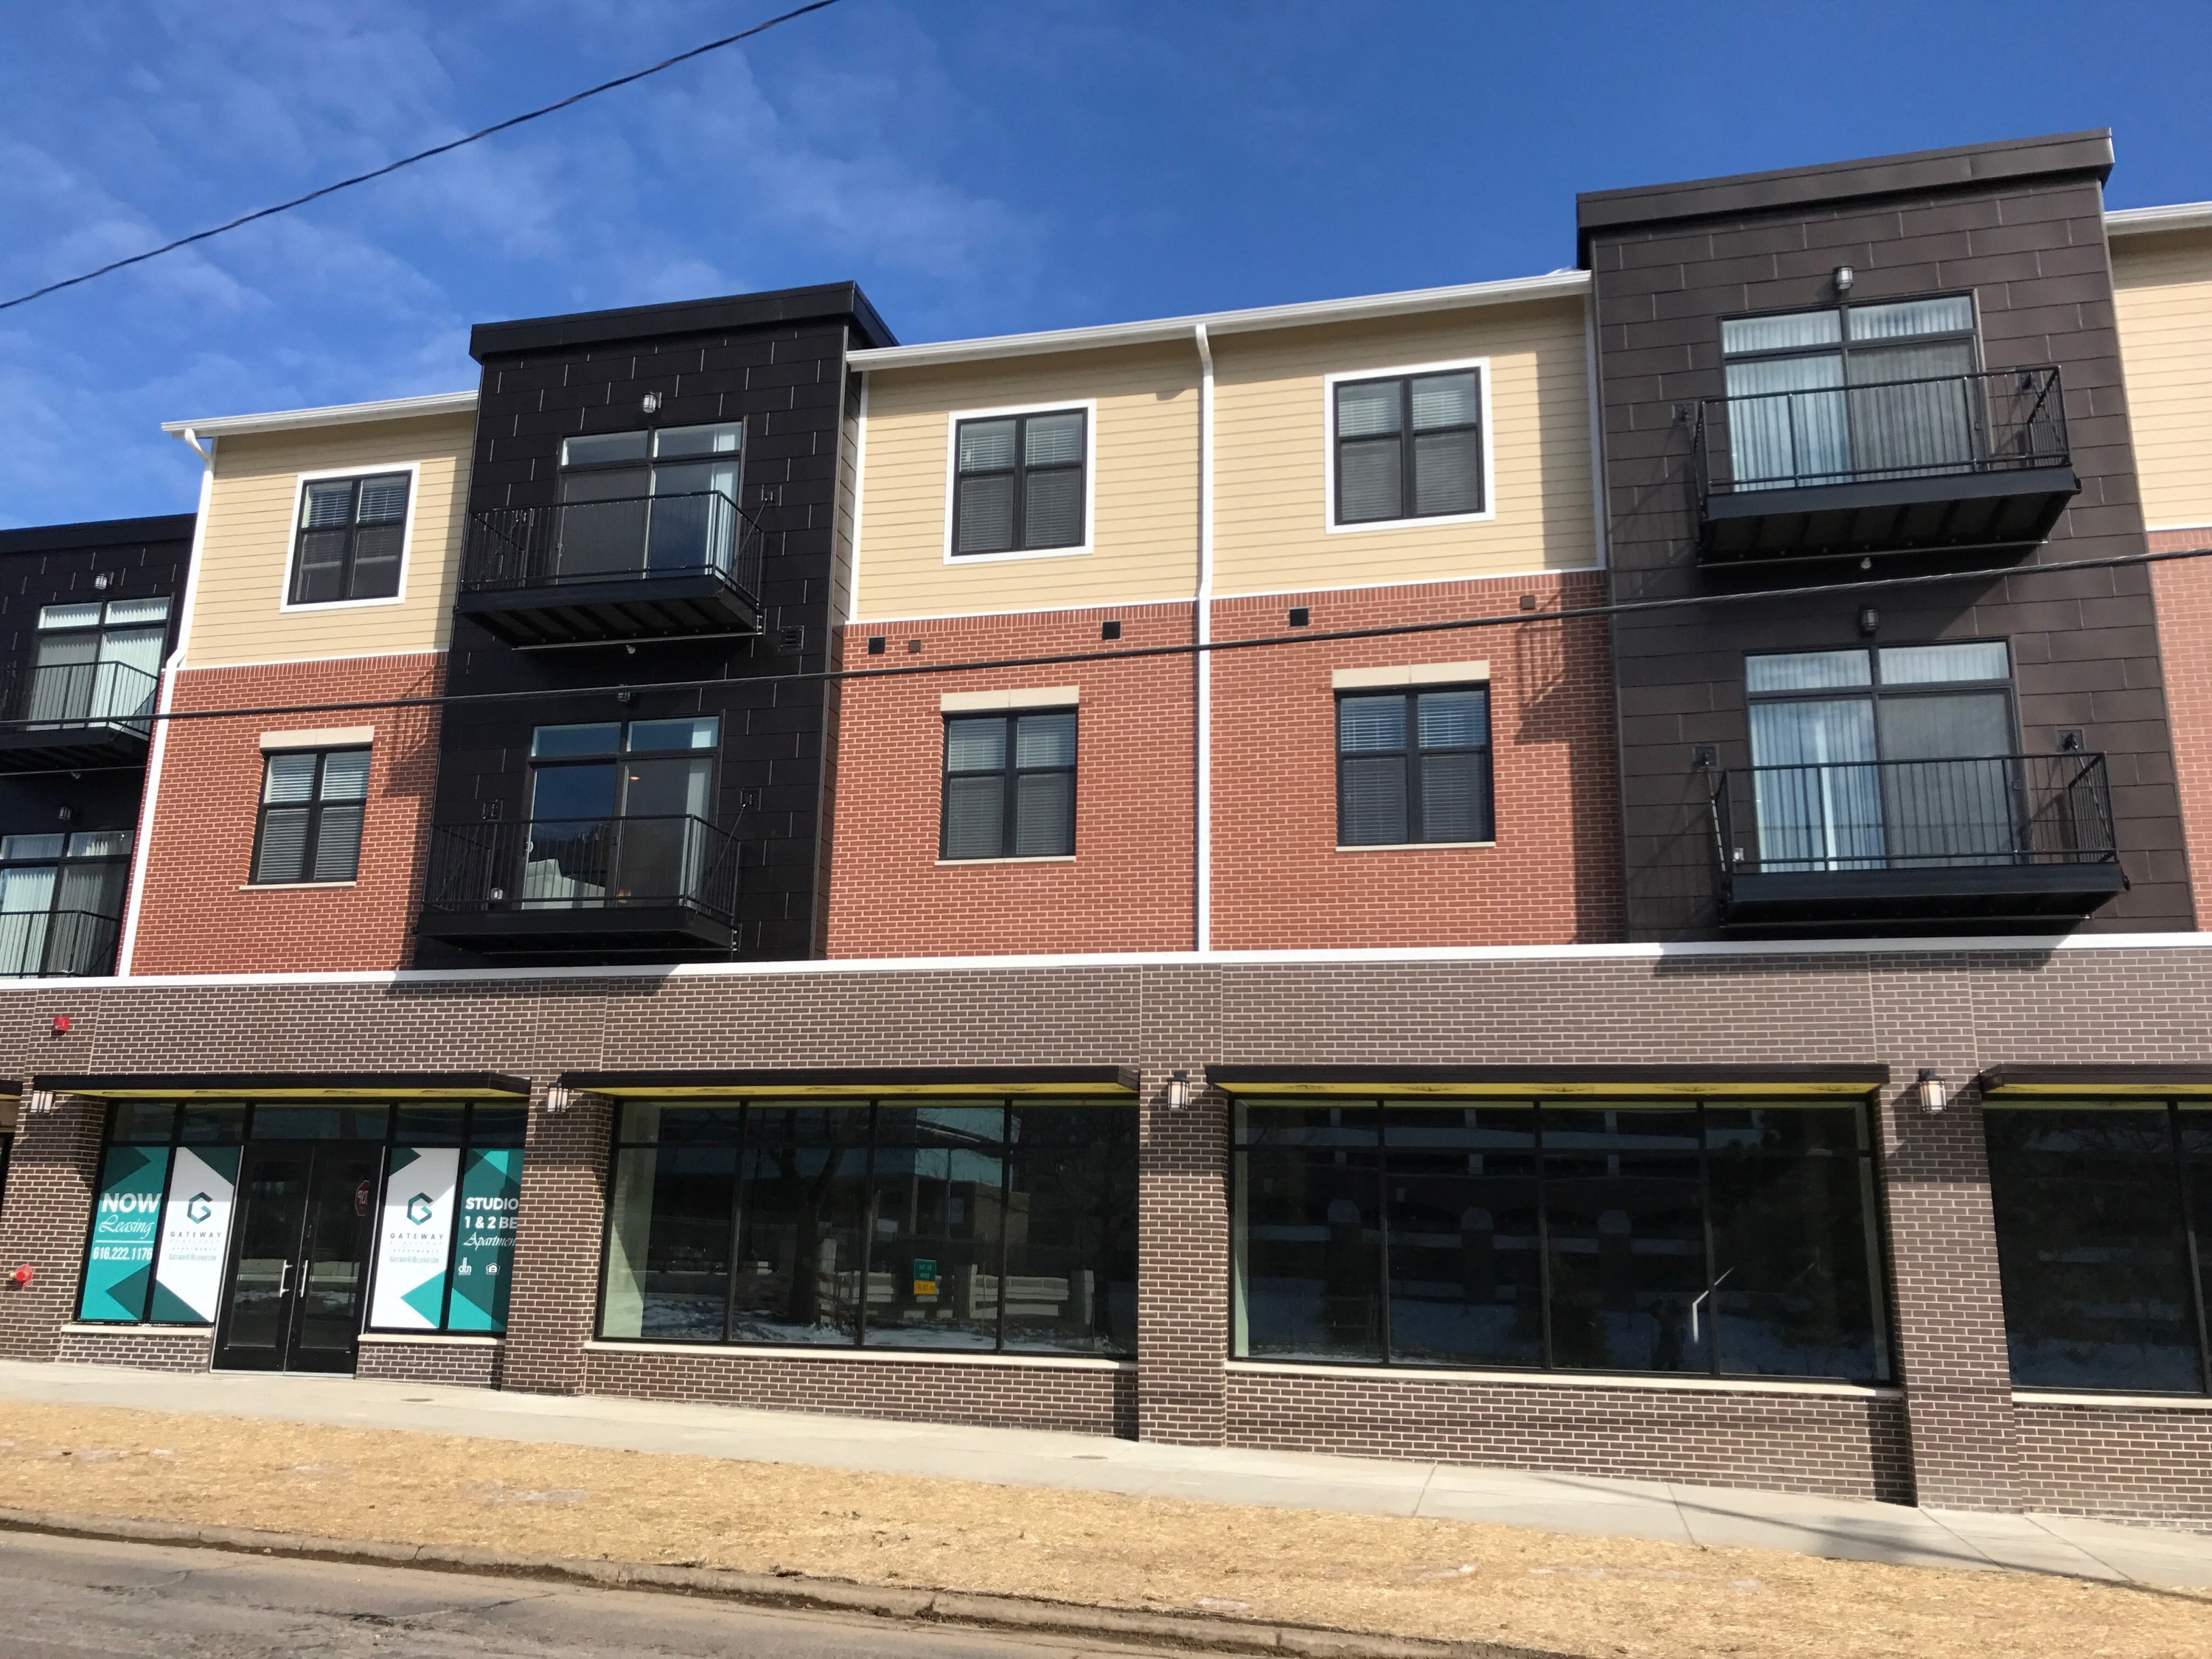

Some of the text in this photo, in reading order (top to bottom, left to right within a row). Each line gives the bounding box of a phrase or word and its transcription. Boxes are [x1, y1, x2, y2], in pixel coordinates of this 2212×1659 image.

[102, 1192, 162, 1213] NOW
[465, 1197, 519, 1210] STUDIO
[99, 1214, 155, 1239] Leasing
[465, 1216, 518, 1229] 1 & 2 BE
[463, 1231, 516, 1251] Apartmen
[93, 1246, 153, 1261] 616.222.1176
